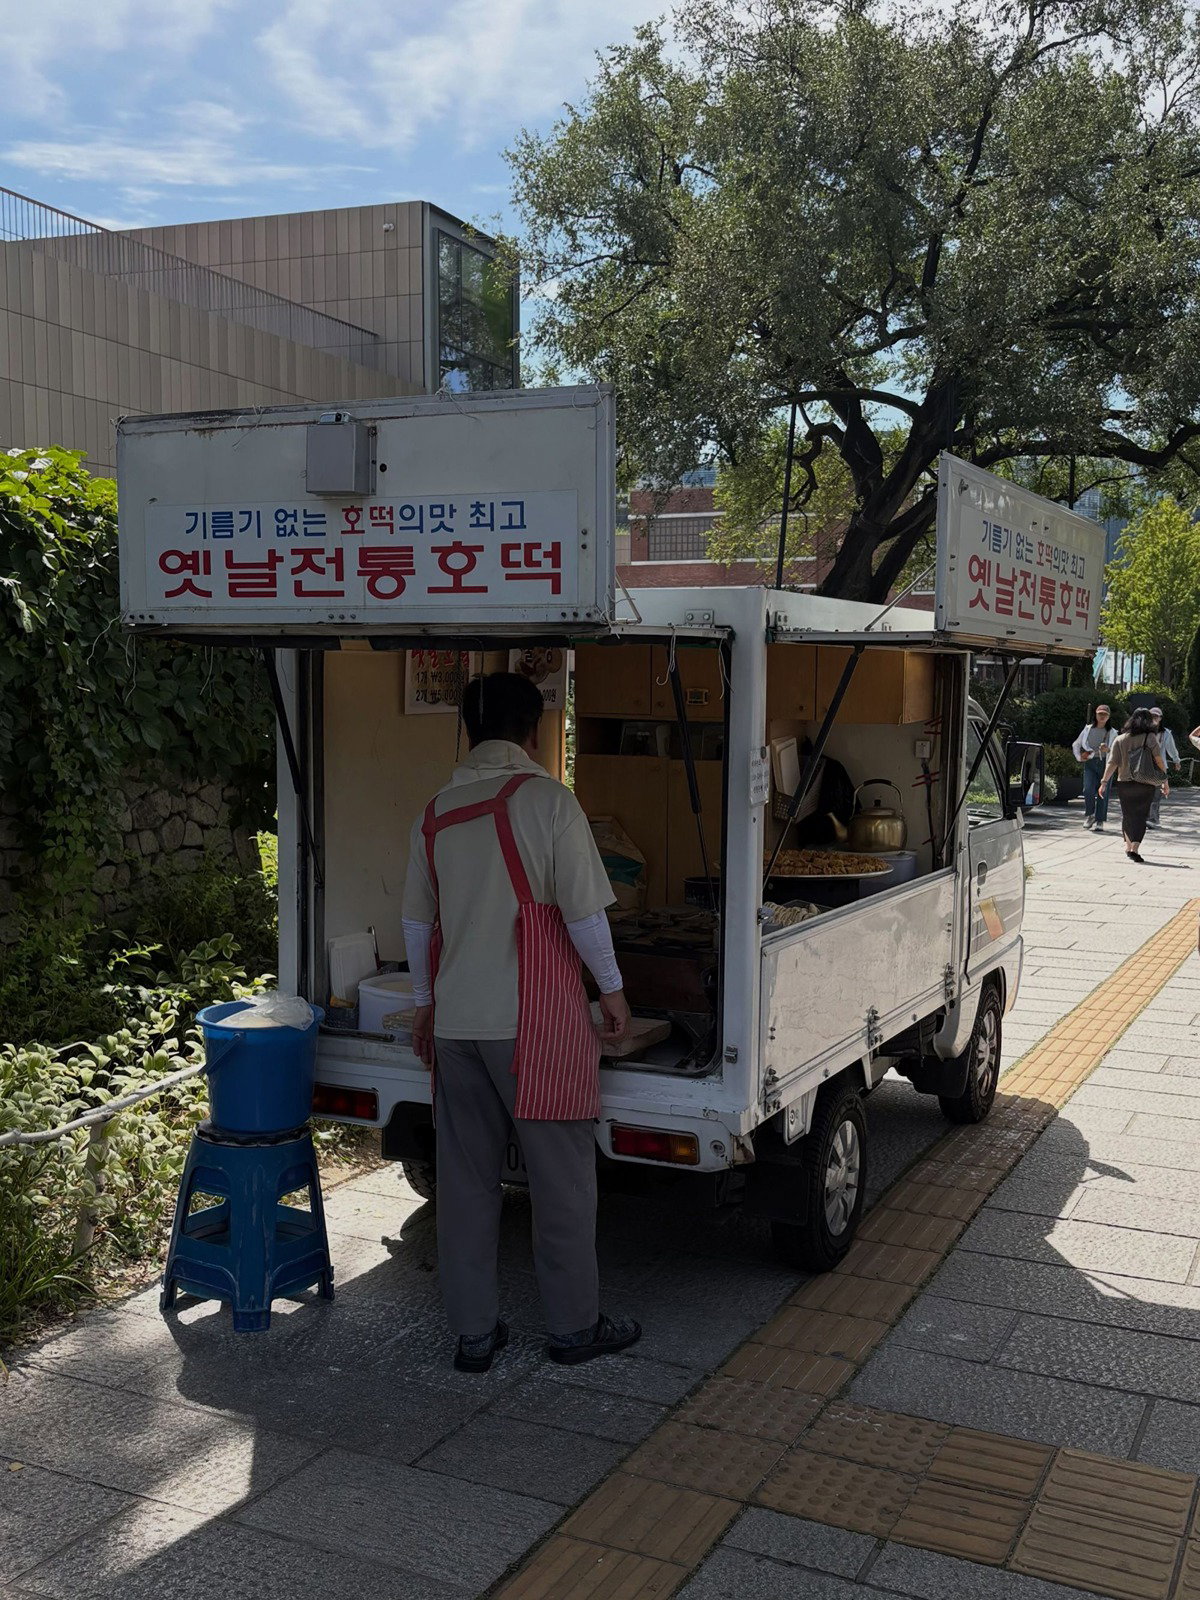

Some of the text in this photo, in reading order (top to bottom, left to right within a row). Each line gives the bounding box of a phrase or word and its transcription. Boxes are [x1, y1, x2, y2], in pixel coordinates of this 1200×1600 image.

[186, 501, 527, 539] 기름기 없는 호떡의맛 최고
[981, 520, 1085, 579] 기름기 없는 호떡의맛 최고
[158, 541, 562, 600] 옛날전통호떡
[968, 554, 1091, 631] 옛날전통호떡
